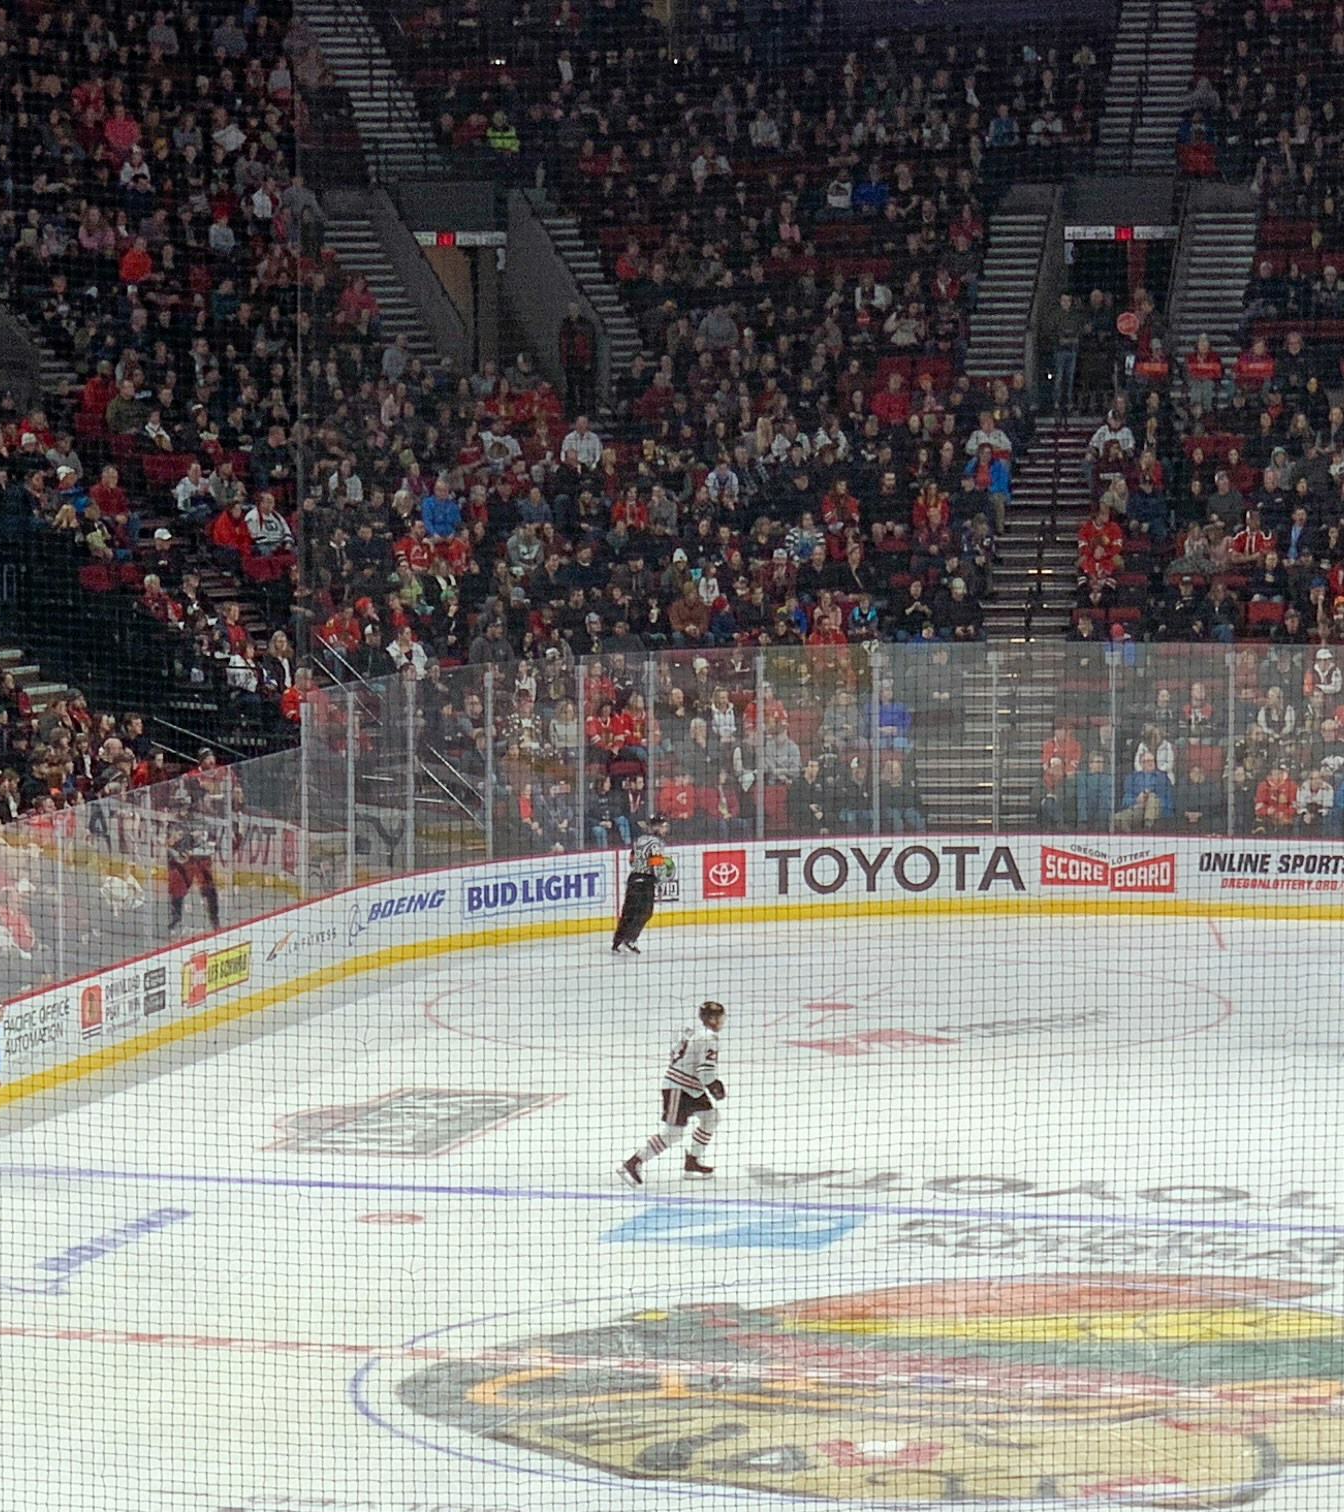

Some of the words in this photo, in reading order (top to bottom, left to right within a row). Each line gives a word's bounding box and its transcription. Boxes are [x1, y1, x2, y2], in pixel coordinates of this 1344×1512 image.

[1070, 844, 1107, 860] OREGON
[1110, 849, 1151, 865] LOTTERY
[1198, 851, 1270, 877] ONLINE
[764, 845, 1027, 895] TOYOTA
[1044, 854, 1105, 881] SCORE
[1113, 861, 1171, 888] BOARD
[367, 889, 446, 922] BOEING
[467, 882, 518, 912] BUD
[523, 872, 600, 903] LIGHT
[3, 1009, 37, 1038] PACIFIC
[40, 998, 71, 1023] OFFICE
[4, 1020, 65, 1055] AUTOMATION
[744, 1168, 1336, 1212] TOYOTA
[900, 1218, 1258, 1246] PACIFIC
